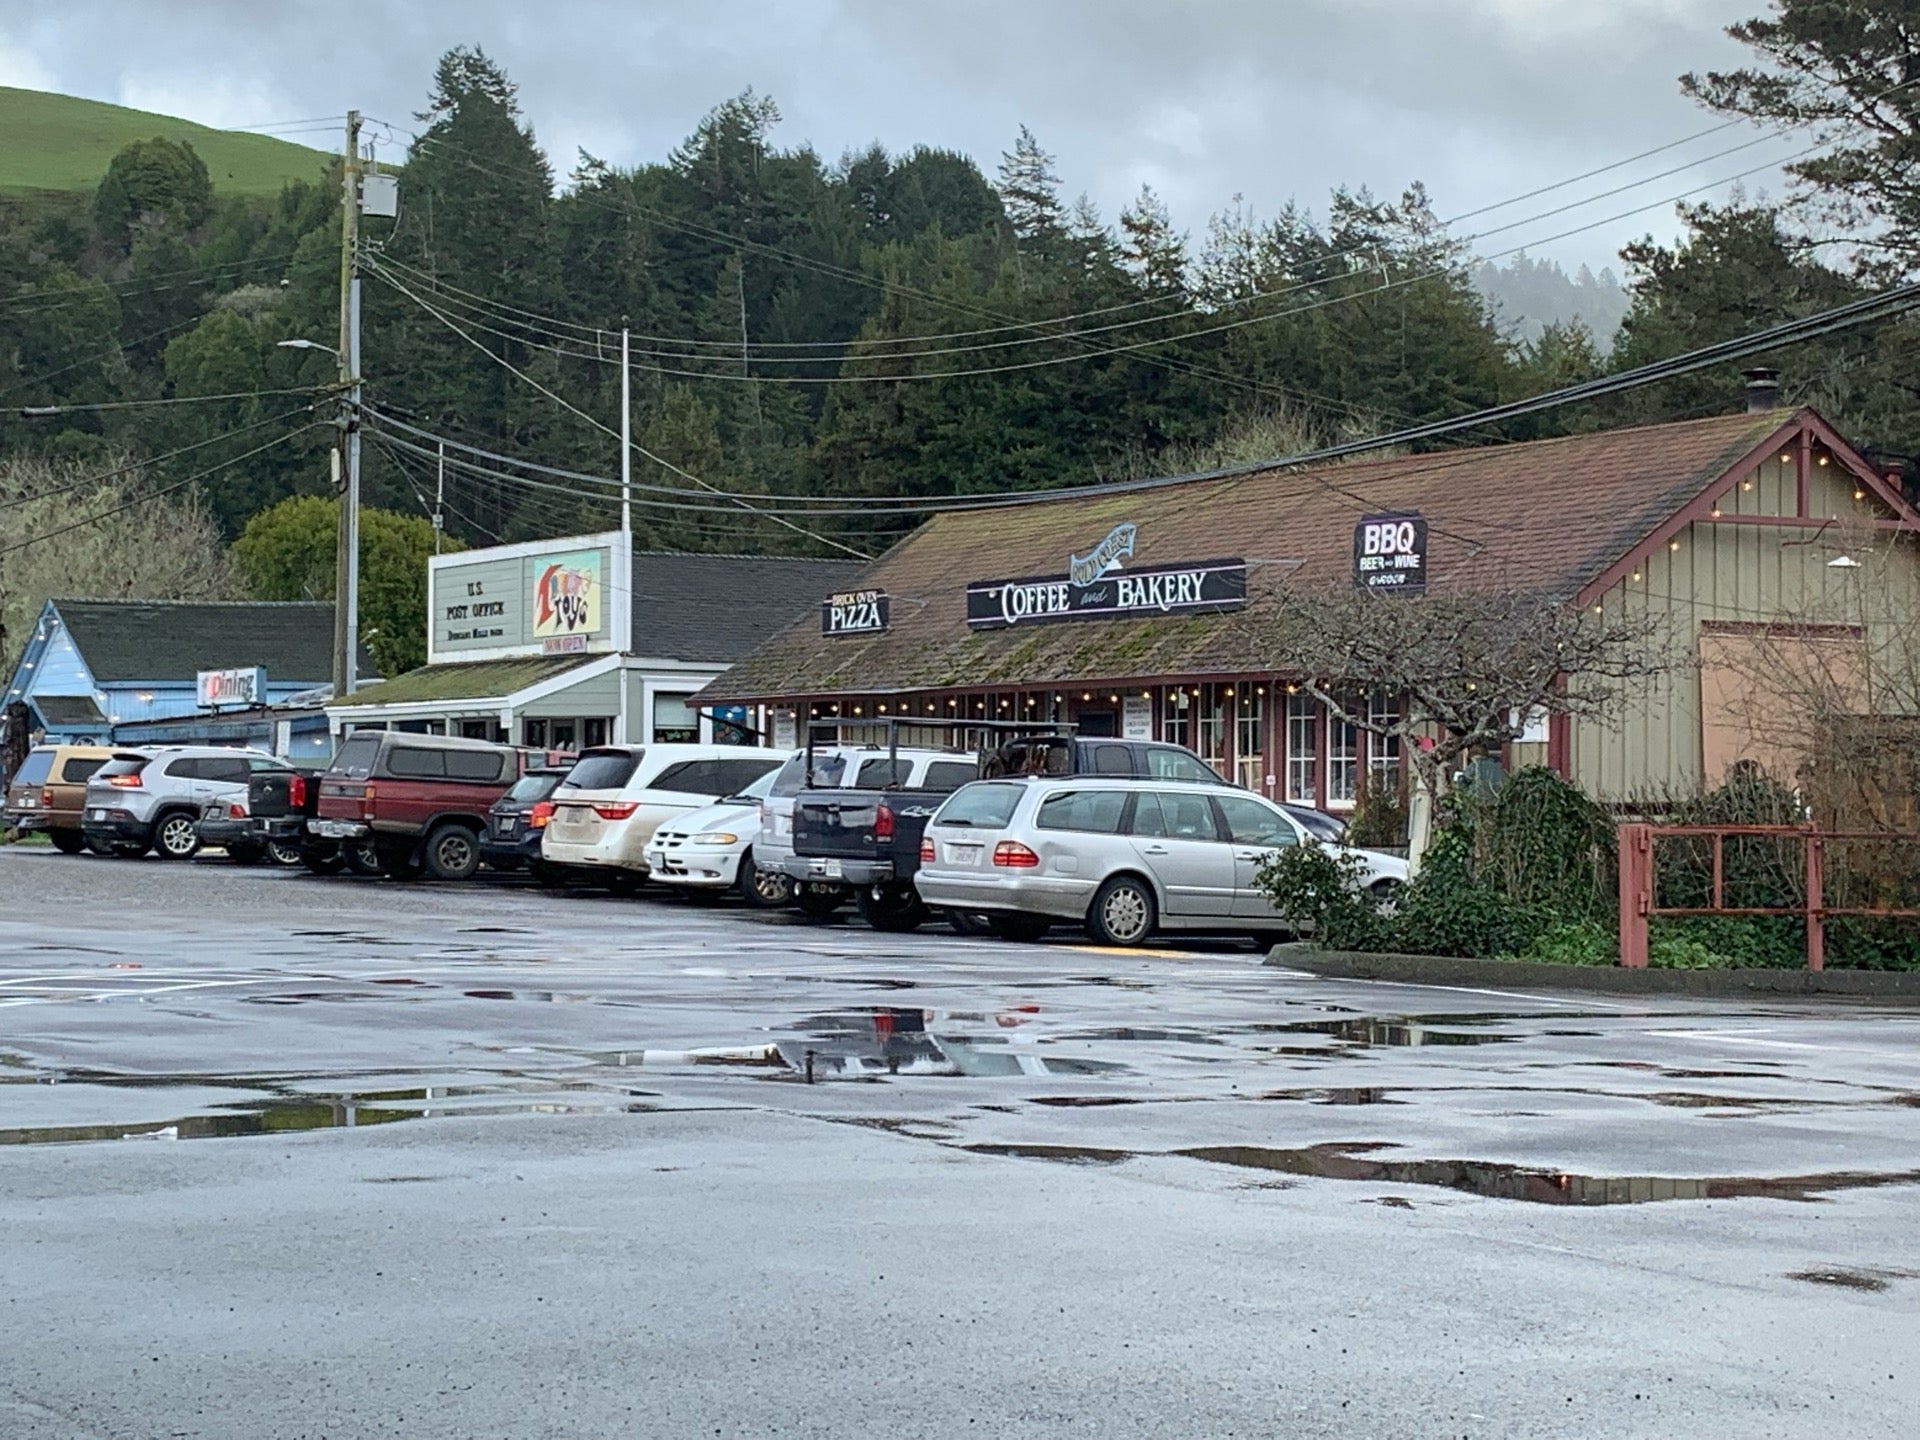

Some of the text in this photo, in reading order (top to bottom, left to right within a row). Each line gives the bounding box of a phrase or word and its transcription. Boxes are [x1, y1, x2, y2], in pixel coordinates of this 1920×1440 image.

[1365, 522, 1413, 554] BBQ
[1360, 556, 1385, 571] BEER
[1394, 554, 1420, 568] WINE
[446, 601, 504, 620] POST OFFICE
[1001, 583, 1072, 624] COFFEE
[1117, 572, 1206, 611] BAKERY
[209, 671, 255, 702] Dining
